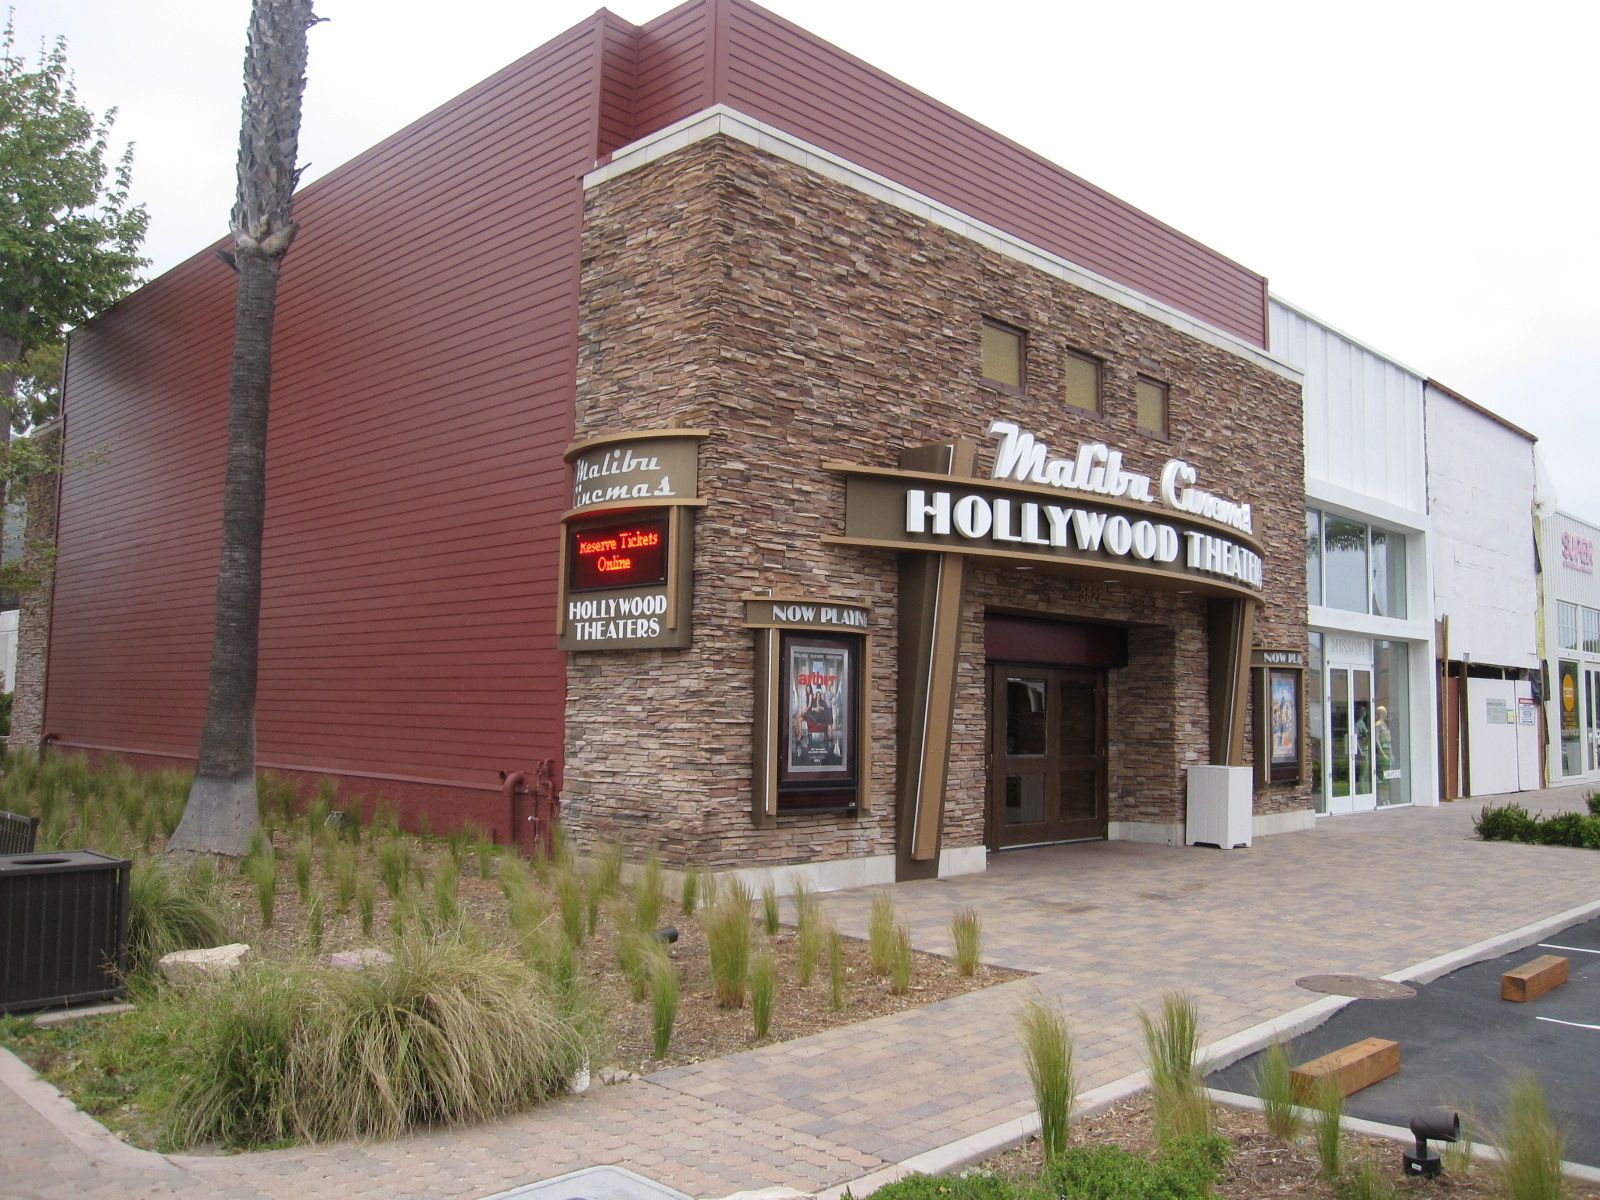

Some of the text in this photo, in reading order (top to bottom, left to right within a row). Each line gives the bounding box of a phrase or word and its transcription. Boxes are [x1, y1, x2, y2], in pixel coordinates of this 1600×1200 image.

[576, 449, 661, 482] Malibu
[990, 420, 1154, 502] Malibu
[906, 489, 1178, 563] HOLLYWOOD
[619, 530, 658, 549] Tickets
[597, 554, 631, 572] Online
[569, 594, 667, 620] HOLLYWOOD
[772, 604, 868, 628] NOW PLAYIN
[575, 617, 660, 640] THEATERS
[1263, 652, 1286, 664] NOW
